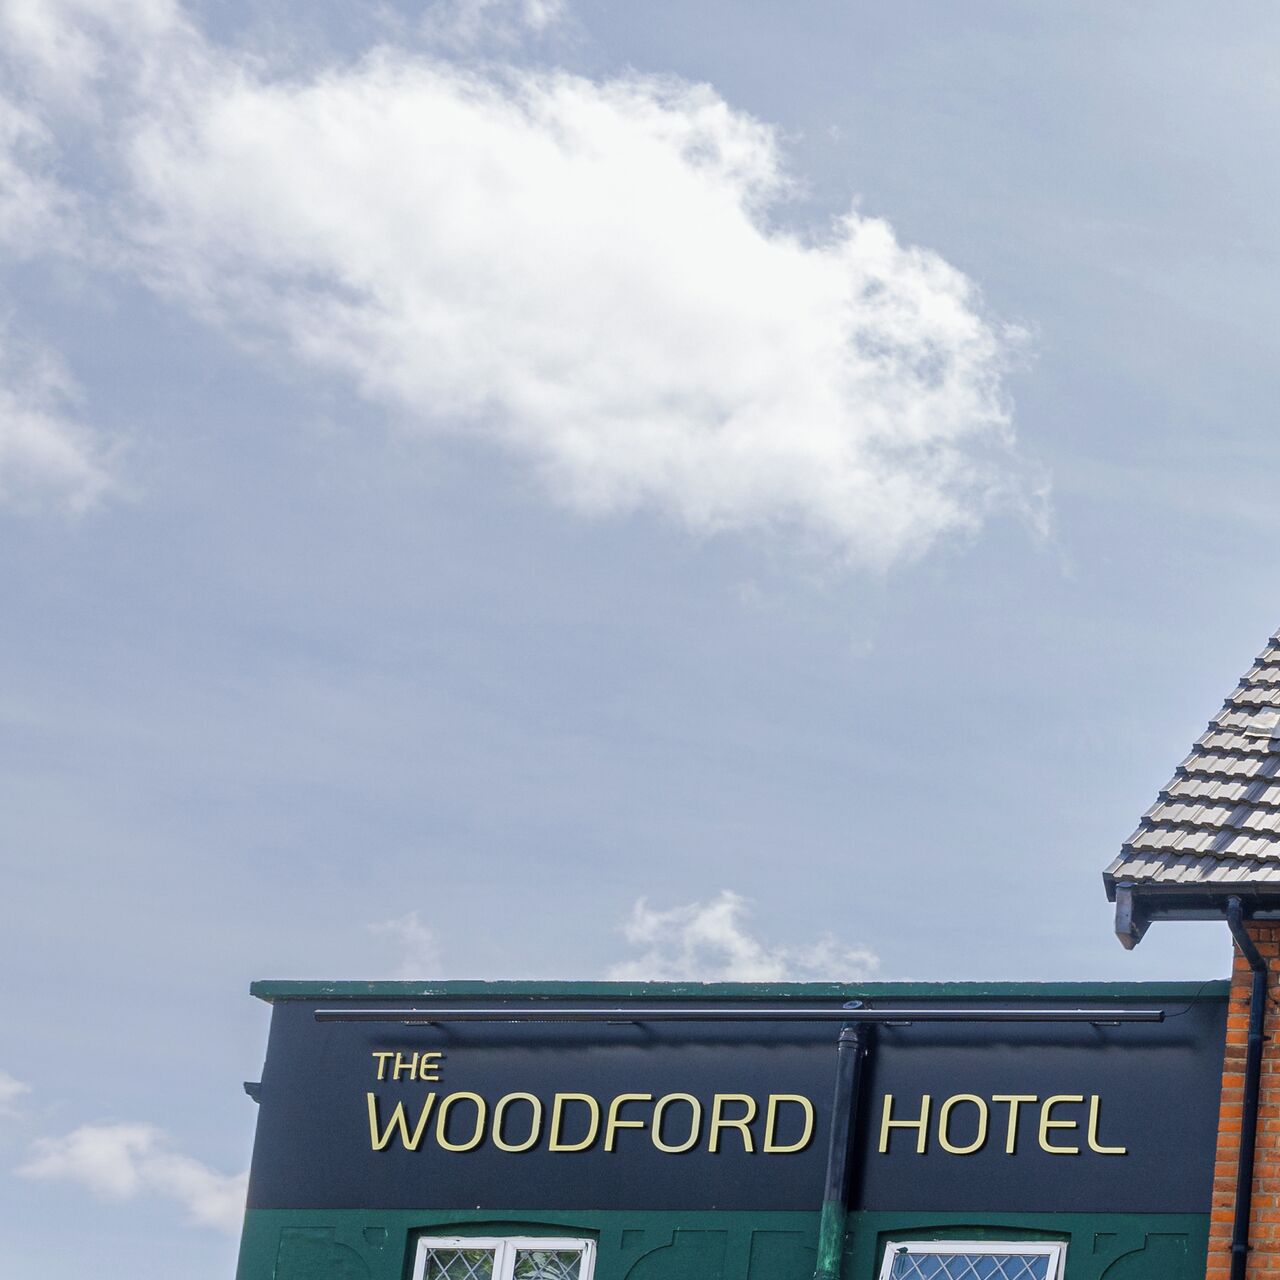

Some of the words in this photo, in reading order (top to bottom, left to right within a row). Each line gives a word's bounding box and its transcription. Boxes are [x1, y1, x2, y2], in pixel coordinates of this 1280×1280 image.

[371, 1052, 442, 1081] THE
[367, 1092, 814, 1152] WOODFORD
[878, 1094, 1127, 1154] HOTEL
